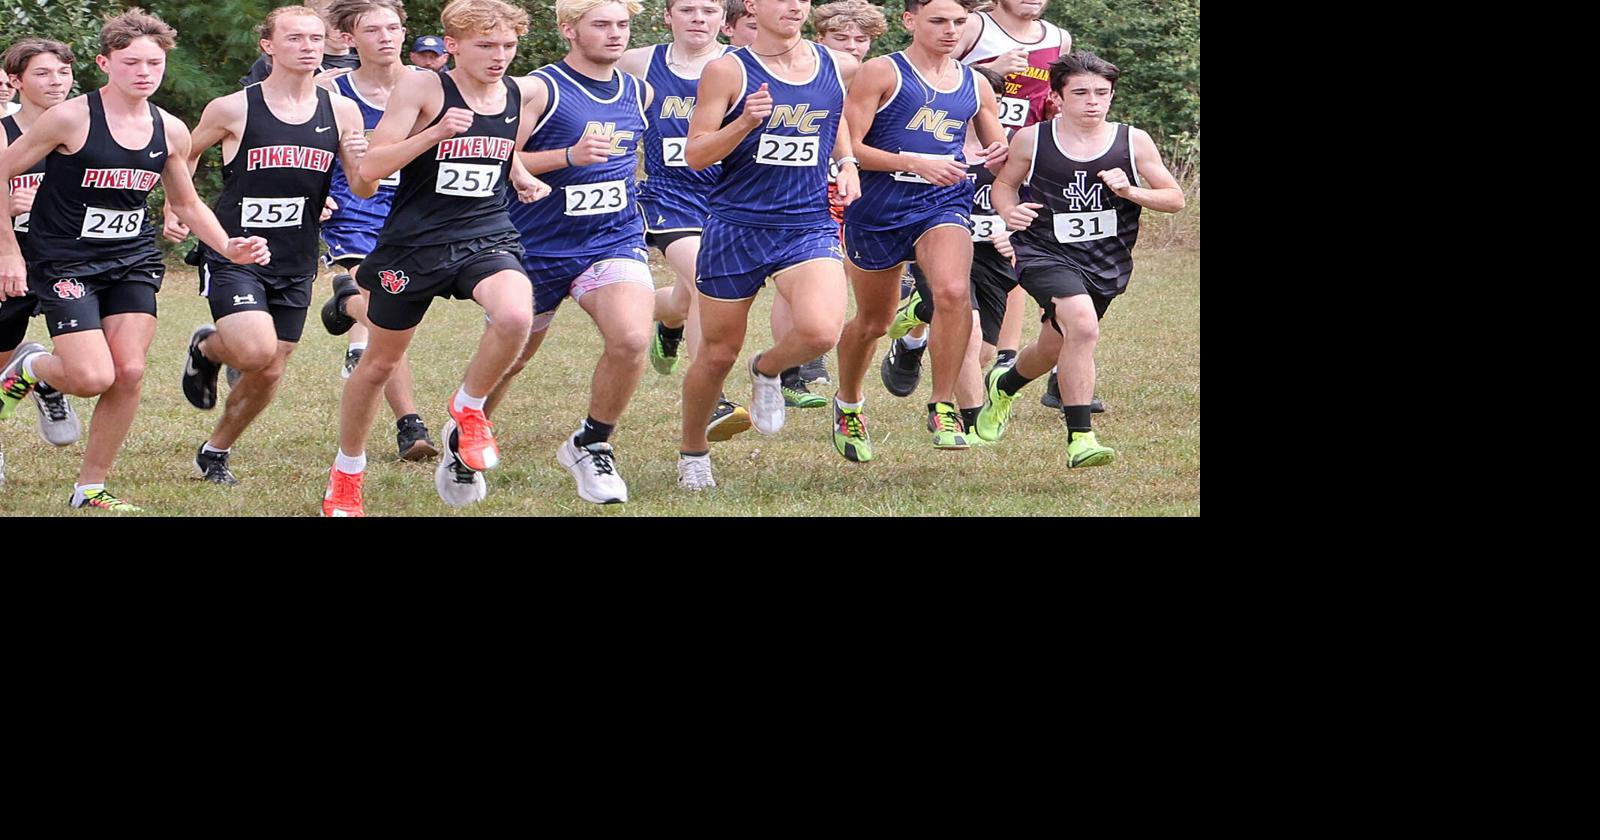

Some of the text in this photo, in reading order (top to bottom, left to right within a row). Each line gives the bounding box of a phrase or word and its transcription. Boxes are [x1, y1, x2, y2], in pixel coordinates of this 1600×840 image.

[660, 96, 696, 122] N
[766, 103, 829, 134] NC
[905, 107, 964, 142] NC
[581, 121, 634, 155] NC
[247, 145, 334, 172] PIKEVIEW
[762, 140, 814, 161] 225
[10, 173, 45, 196] PIK
[441, 169, 493, 191] 251
[966, 173, 991, 209] M
[571, 187, 622, 211] 223
[87, 213, 139, 233] 248
[247, 203, 299, 223] 252
[1069, 217, 1103, 237] 31
